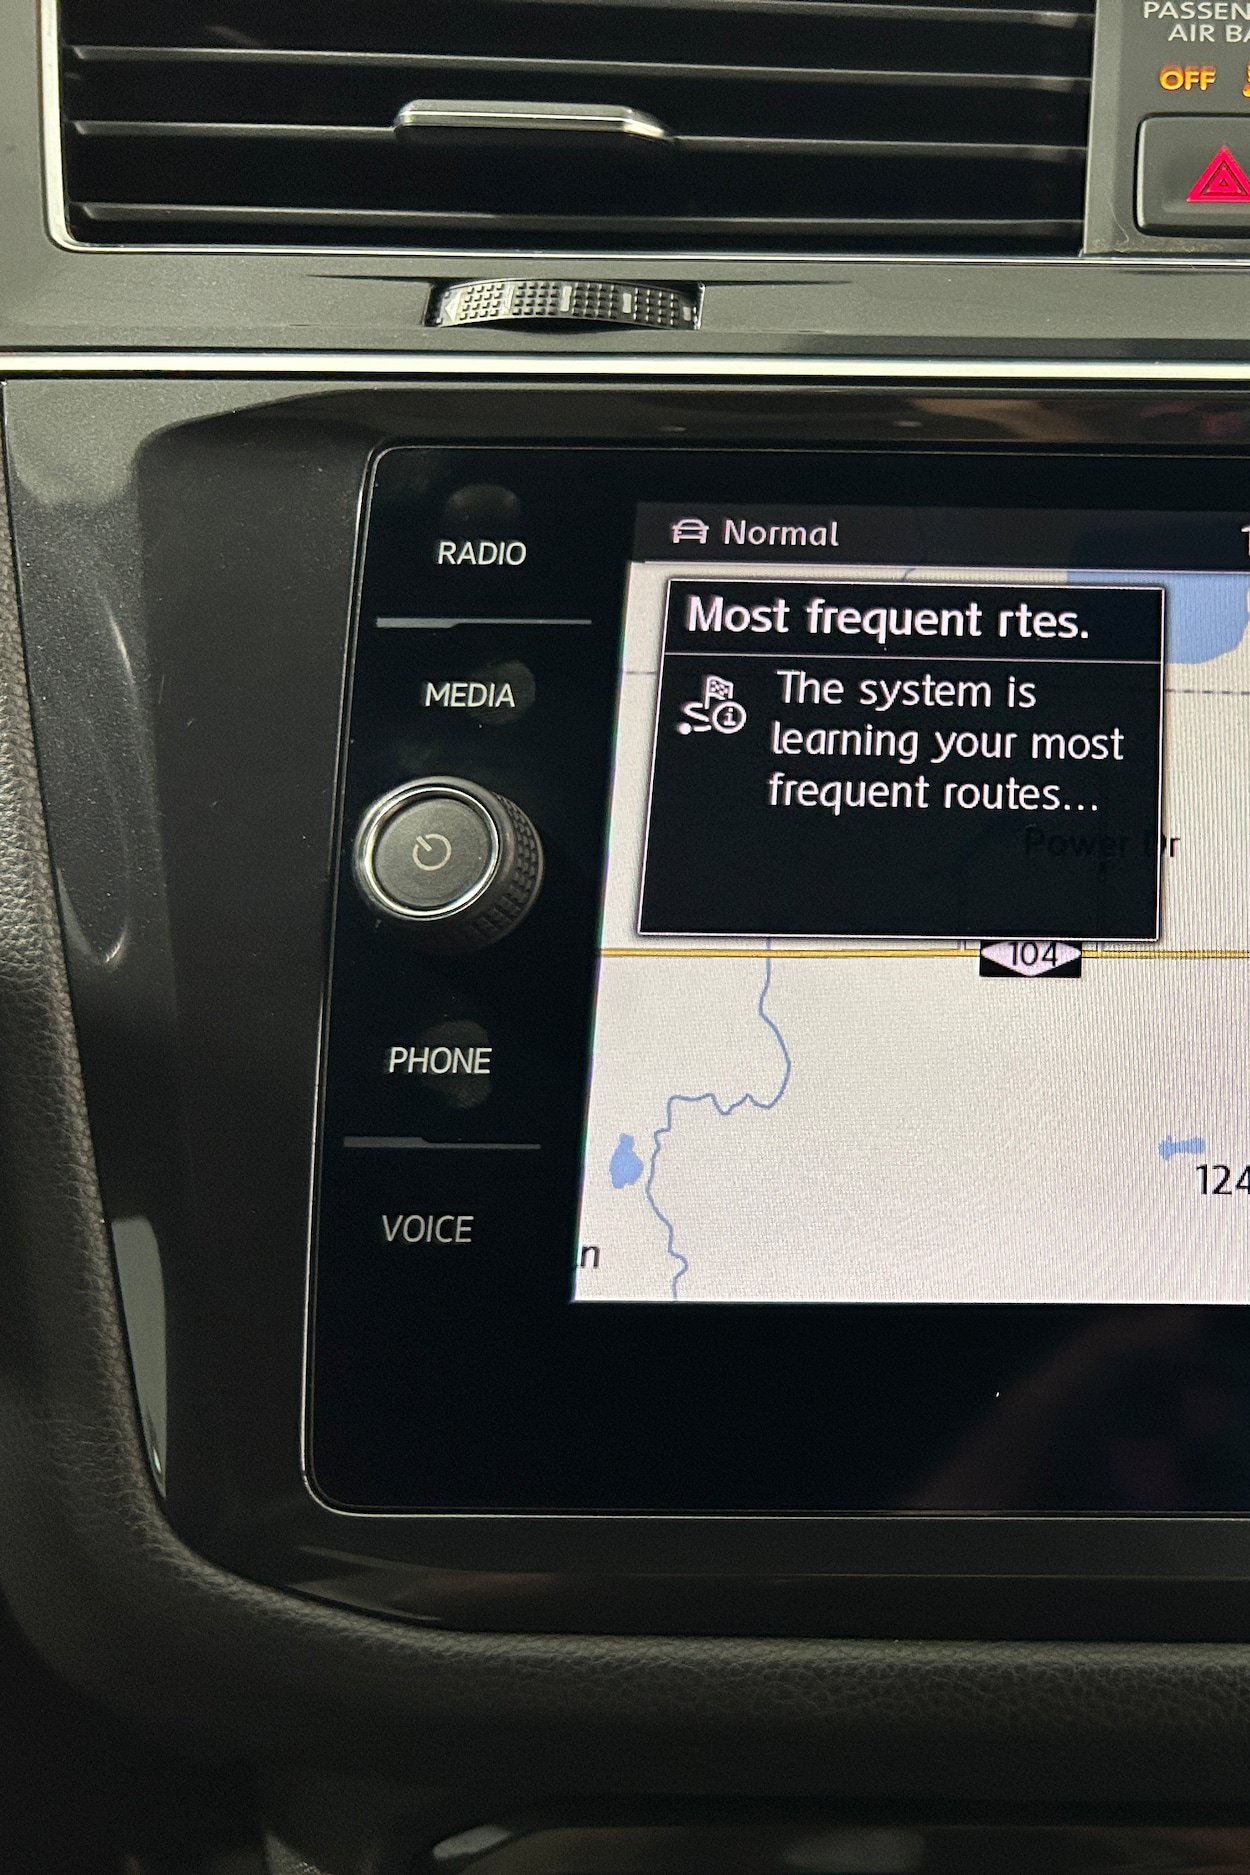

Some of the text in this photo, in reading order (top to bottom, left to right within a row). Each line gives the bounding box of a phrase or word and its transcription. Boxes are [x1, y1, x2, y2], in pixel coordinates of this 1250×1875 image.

[1168, 25, 1215, 42] AIR
[1159, 66, 1216, 91] OFF
[723, 518, 840, 547] Normal
[437, 540, 527, 566] RADIO
[687, 596, 1089, 643] Most frequent rtes.
[424, 682, 515, 708] MEDIA
[777, 670, 1037, 711] The system is
[771, 721, 1124, 763] learning your most
[768, 773, 1099, 816] frequent routes...
[1010, 941, 1059, 967] 104
[388, 1046, 493, 1074] PHONE
[381, 1214, 474, 1243] VOICE
